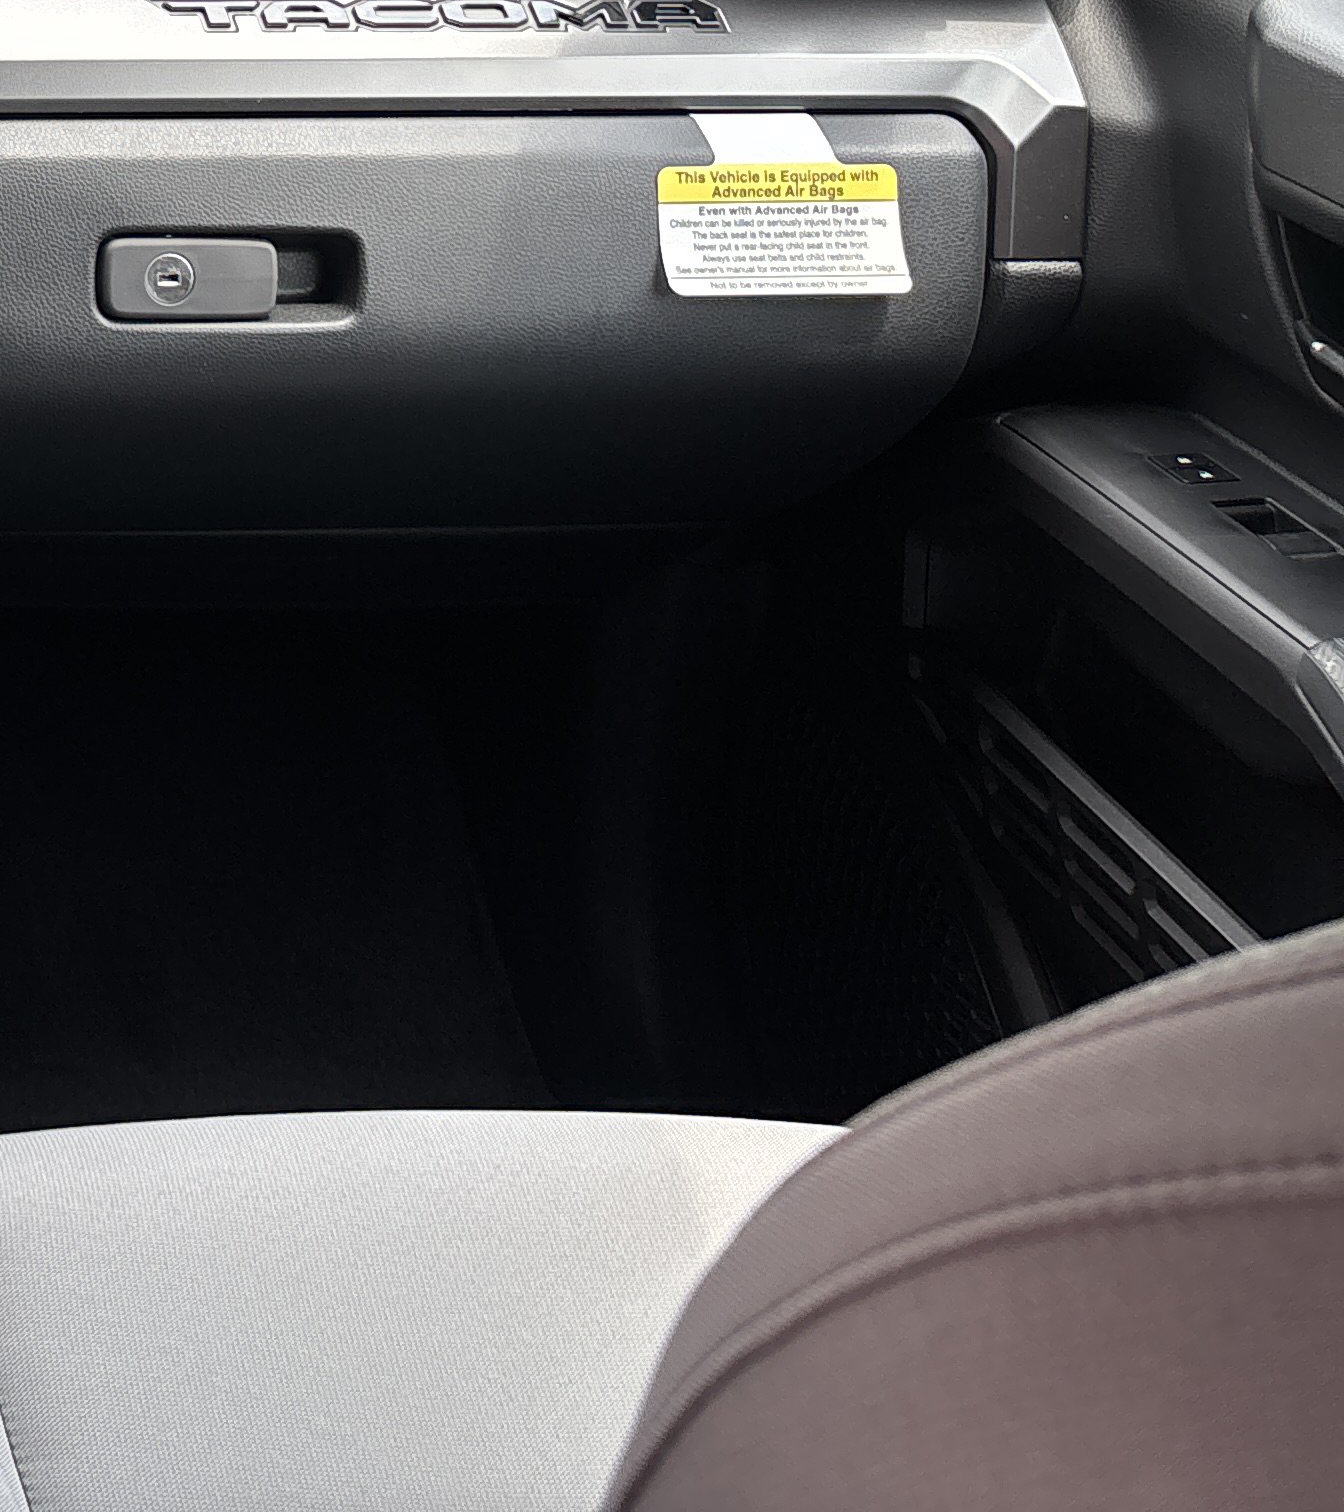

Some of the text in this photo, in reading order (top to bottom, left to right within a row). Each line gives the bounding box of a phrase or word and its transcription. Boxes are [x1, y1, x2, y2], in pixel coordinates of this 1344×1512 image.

[675, 170, 705, 184] This
[709, 170, 760, 184] Vehicle
[780, 169, 846, 186] Equipped
[849, 169, 879, 182] with
[711, 184, 844, 200] Advanced Air Bags
[698, 204, 860, 217] Even with Advanced Air Bags
[669, 219, 703, 229] Children
[704, 220, 719, 228] can
[721, 219, 732, 228] be
[733, 219, 755, 228] killed
[756, 220, 765, 228] or
[766, 219, 803, 229] seriously
[804, 218, 831, 229] injured
[832, 218, 843, 229] by
[844, 218, 858, 226] the
[859, 218, 869, 226] air
[692, 230, 708, 240] The
[709, 230, 729, 240] back
[730, 230, 748, 240] seat
[749, 230, 757, 239] is
[758, 230, 772, 239] the
[773, 229, 797, 239] safest
[798, 230, 821, 240] place
[822, 229, 833, 238] for
[693, 242, 717, 252] Never
[718, 243, 732, 252] put
[785, 242, 805, 250] child
[806, 241, 824, 250] seat
[834, 241, 848, 249] the
[702, 254, 730, 264] Always
[732, 255, 747, 263] use
[748, 254, 766, 263] seat
[767, 254, 788, 263] belts
[789, 253, 805, 262] and
[806, 253, 825, 262] child
[757, 265, 768, 273] for
[838, 263, 862, 272] about
[710, 281, 727, 289] Not
[728, 281, 738, 289] to
[739, 281, 752, 289] be
[826, 280, 838, 289] by
